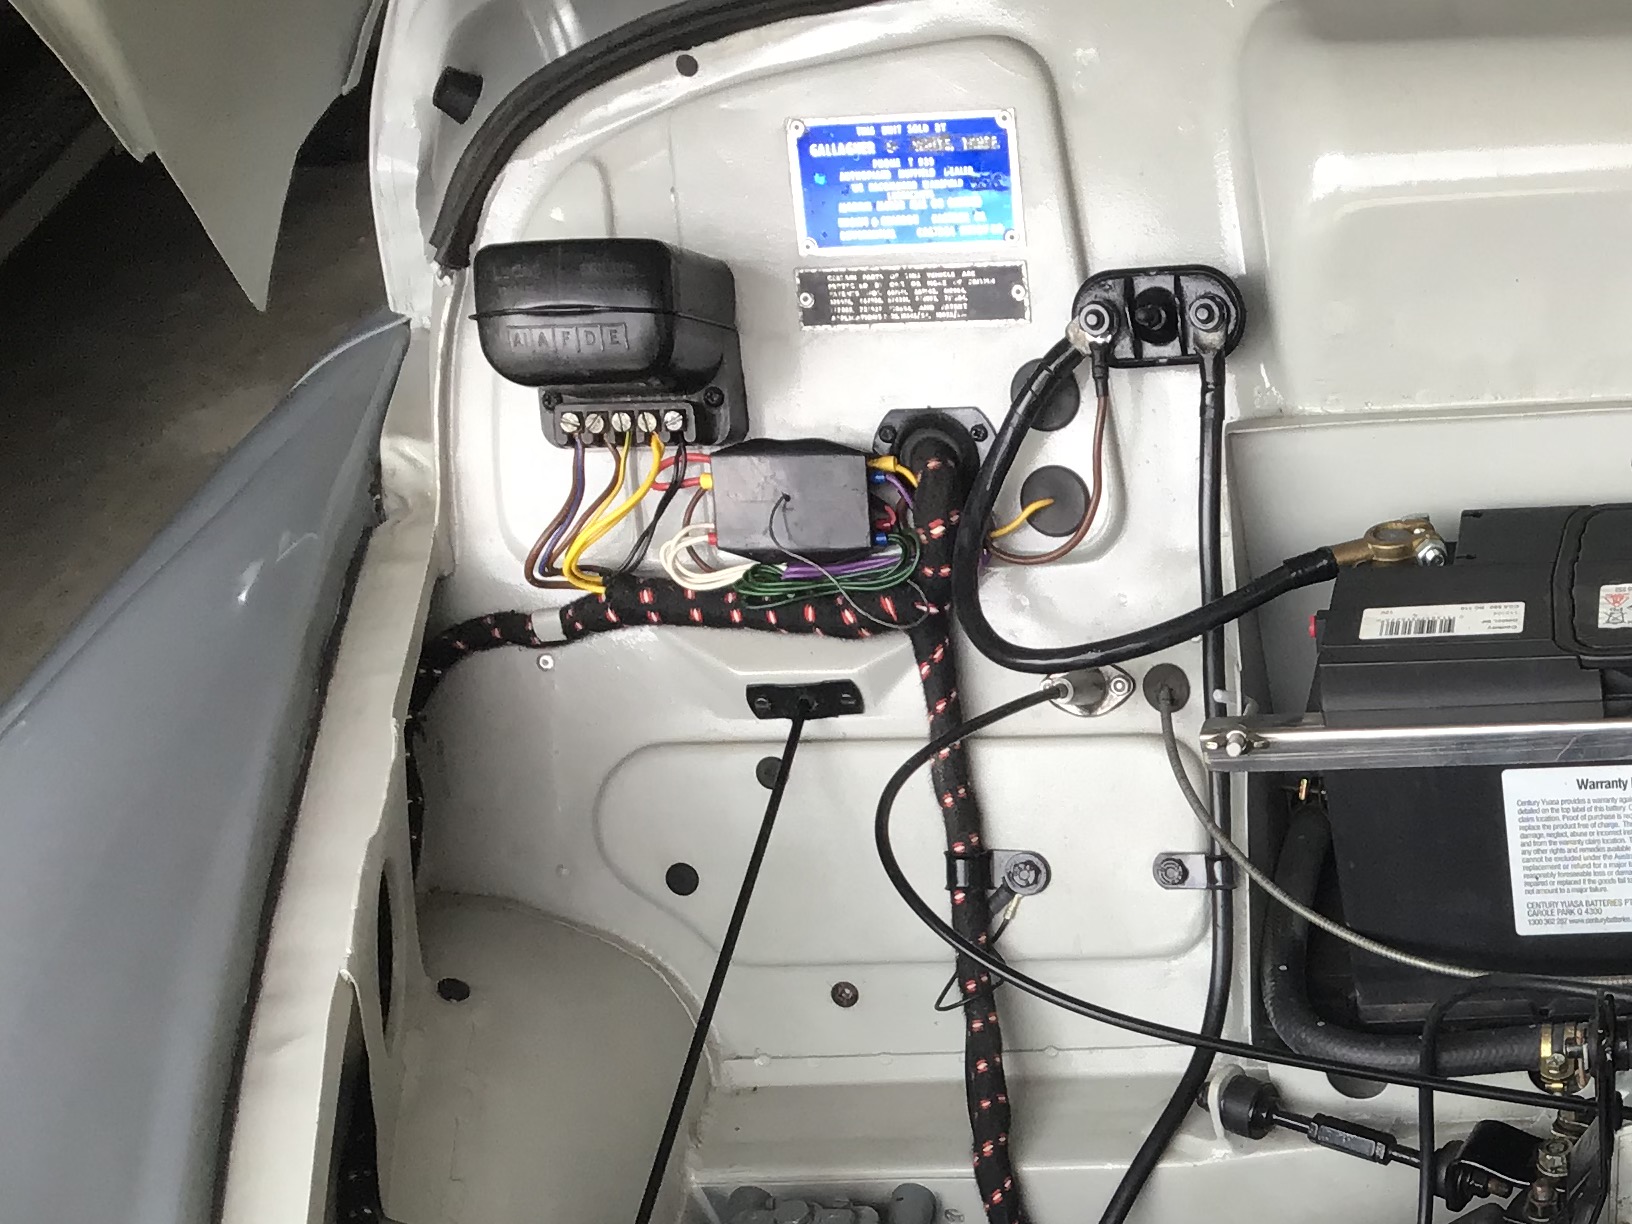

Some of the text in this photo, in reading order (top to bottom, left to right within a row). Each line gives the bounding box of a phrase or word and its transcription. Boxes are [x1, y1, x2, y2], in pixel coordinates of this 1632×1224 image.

[609, 329, 621, 345] E
[1576, 777, 1628, 791] Warranty
[1527, 901, 1558, 909] CENTURY
[1528, 909, 1555, 917] CAROLE
[1557, 908, 1575, 916] PARK
